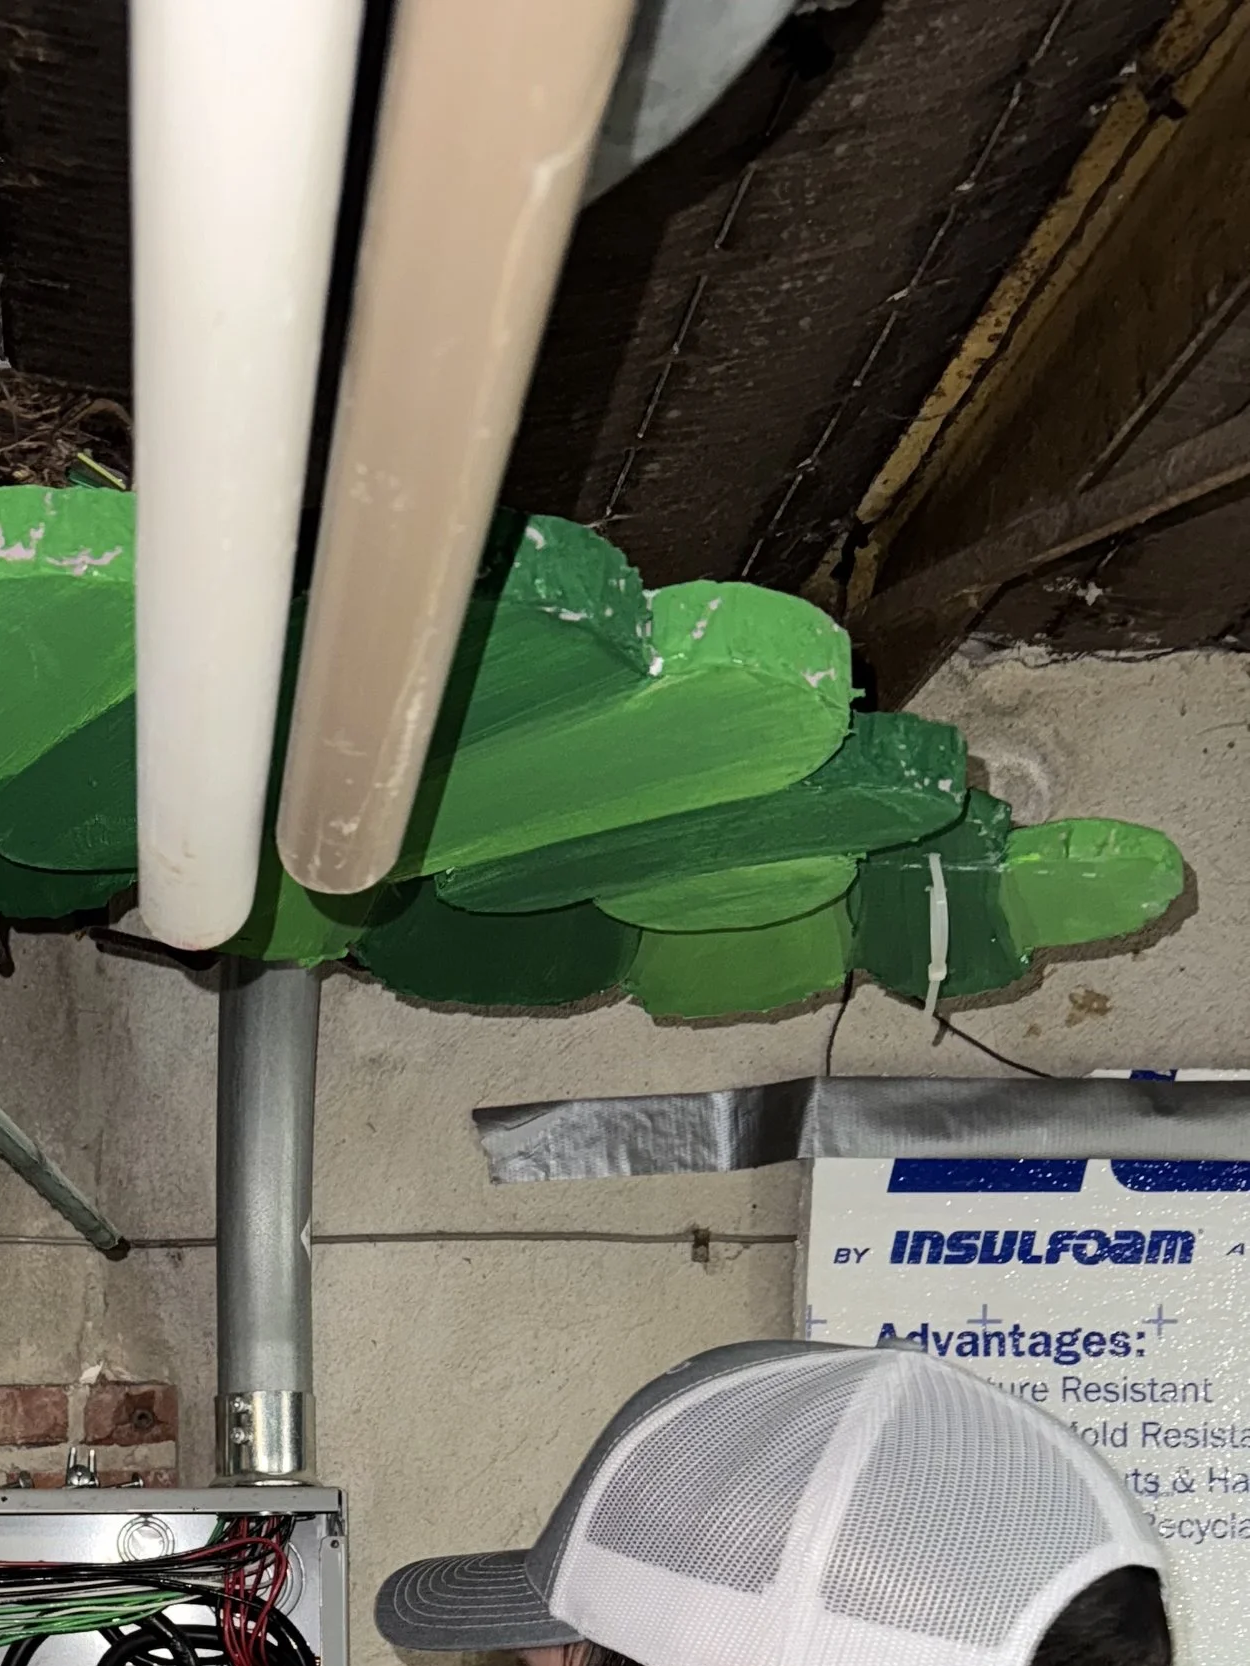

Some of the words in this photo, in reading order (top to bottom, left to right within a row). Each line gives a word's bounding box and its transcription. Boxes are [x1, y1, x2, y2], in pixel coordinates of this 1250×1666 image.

[833, 1247, 871, 1264] BY
[1062, 1376, 1213, 1403] Resistant
[1172, 1465, 1196, 1494] &
